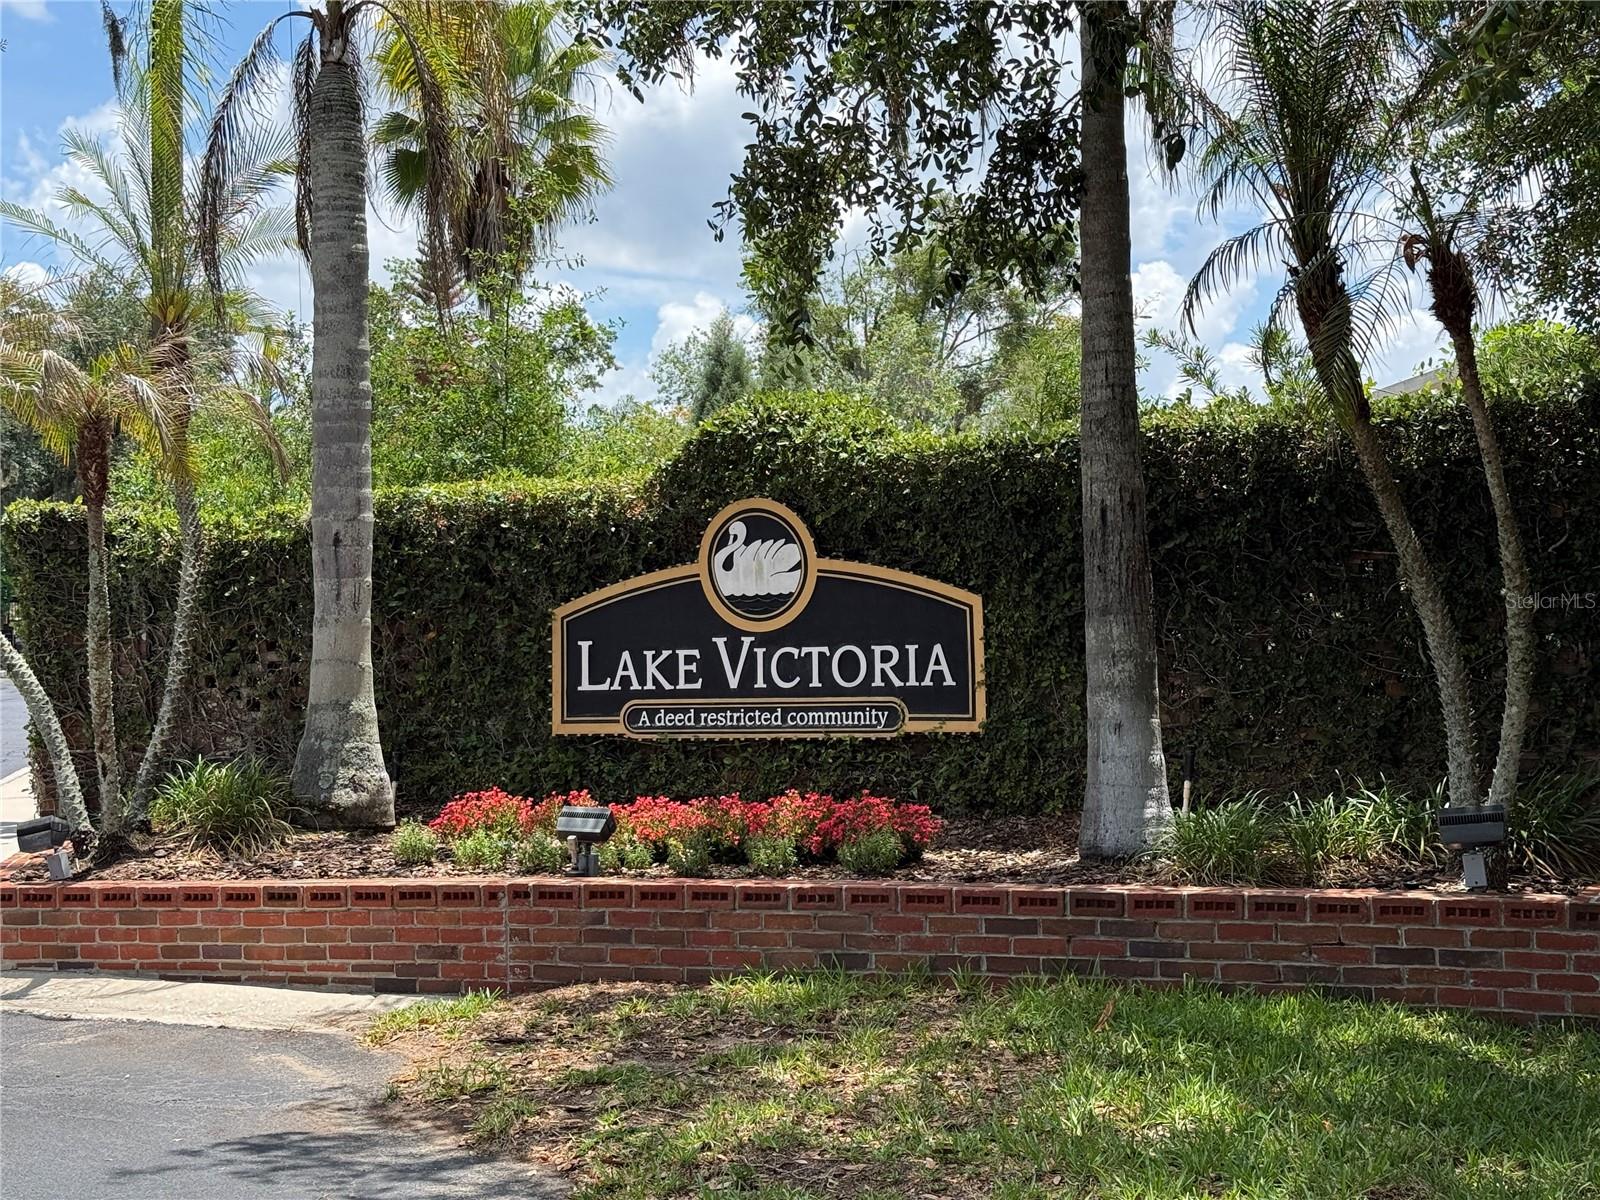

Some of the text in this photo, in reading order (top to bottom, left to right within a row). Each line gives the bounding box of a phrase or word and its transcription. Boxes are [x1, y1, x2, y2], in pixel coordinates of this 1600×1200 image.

[577, 636, 956, 692] LAKE VICTORIA
[638, 708, 888, 729] A deed restricted community
